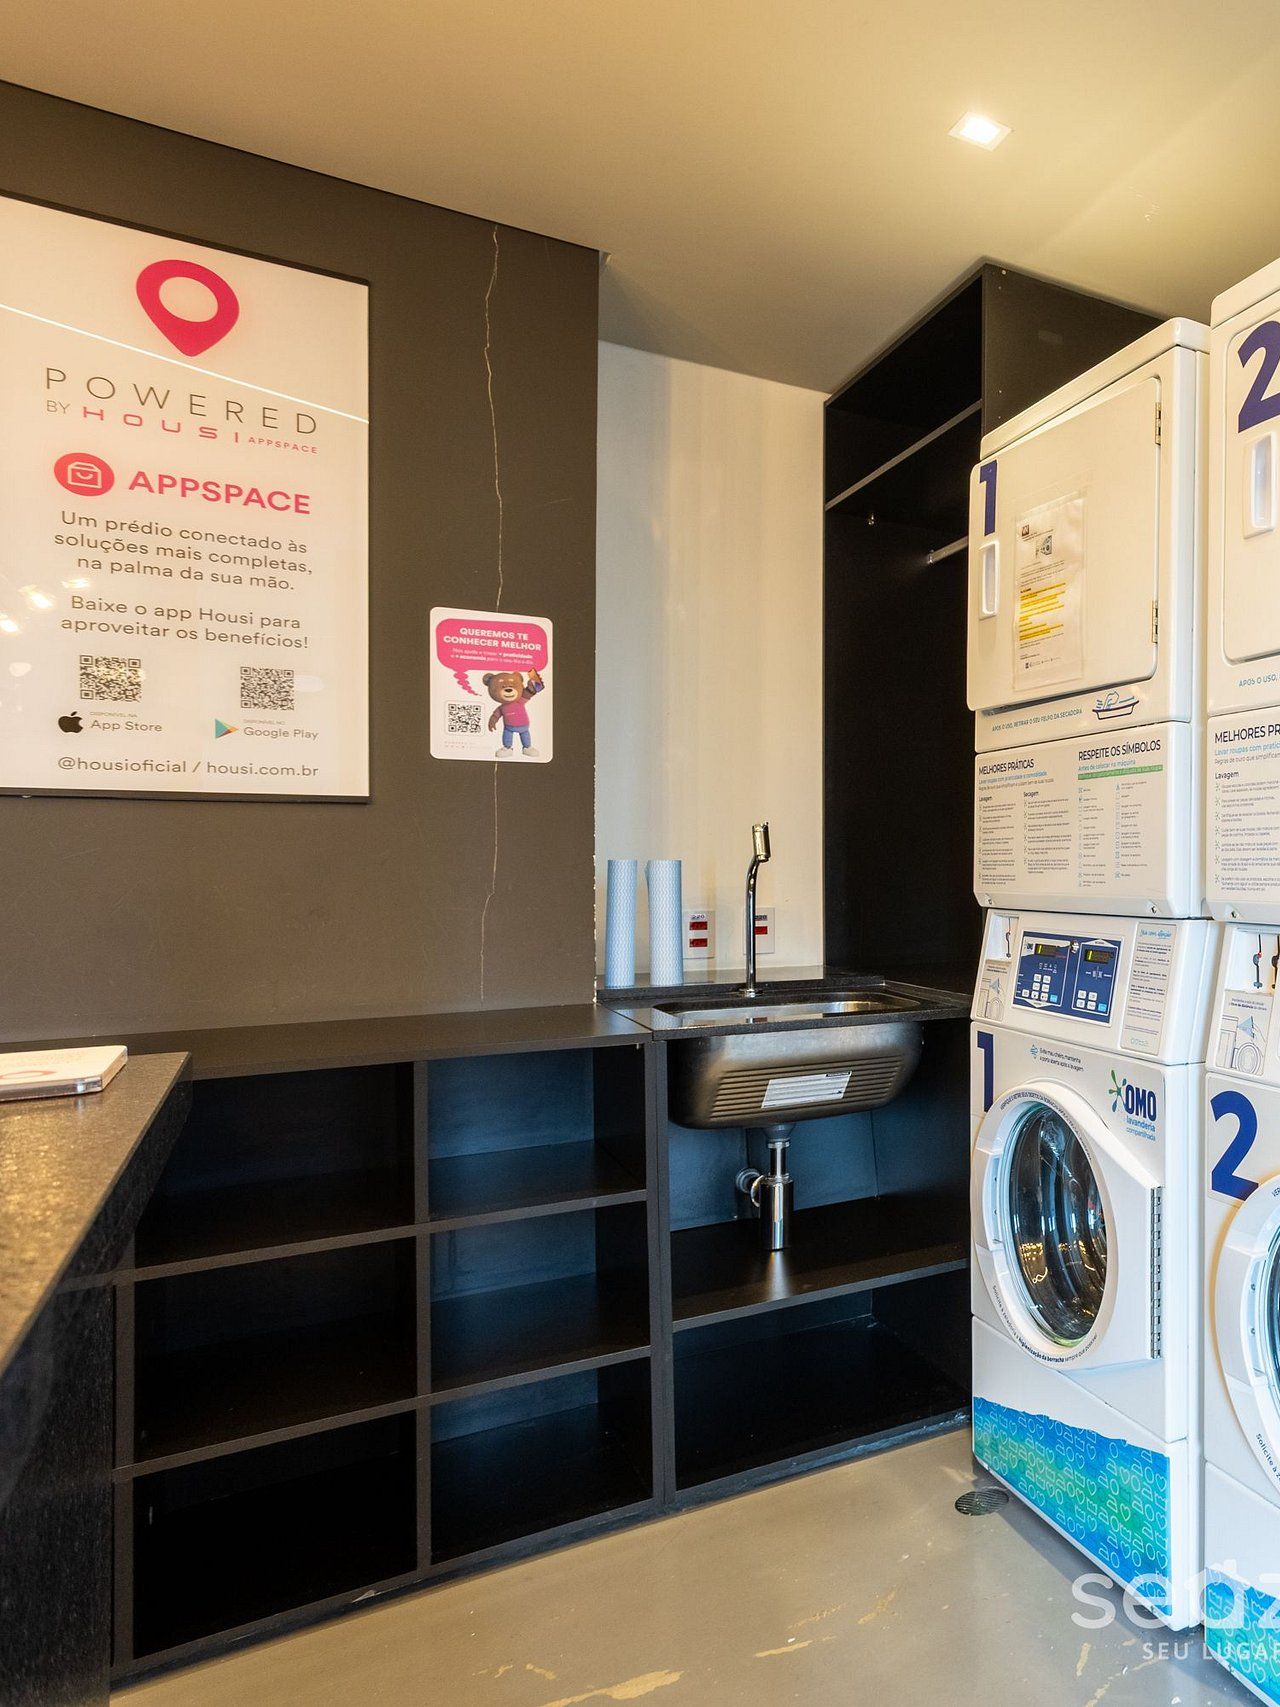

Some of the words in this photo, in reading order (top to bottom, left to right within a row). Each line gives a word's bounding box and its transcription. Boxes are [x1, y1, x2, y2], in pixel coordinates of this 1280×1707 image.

[46, 367, 317, 435] POWERED
[46, 400, 70, 414] BY
[248, 436, 318, 454] APPSPACE
[128, 470, 311, 515] APPSPACE
[980, 460, 997, 536] 1
[60, 510, 96, 529] Um
[105, 518, 172, 538] prédio
[179, 528, 281, 550] conectado
[288, 537, 308, 553] às
[54, 534, 148, 556] soluções
[156, 545, 201, 562] mais
[208, 552, 313, 575] completas,
[76, 557, 101, 570] na
[110, 560, 172, 578] palma
[179, 565, 203, 581] da
[210, 571, 242, 585] sua
[249, 573, 295, 591] mão.
[70, 595, 127, 614] Baixe
[134, 604, 146, 615] o
[154, 605, 191, 622] app
[199, 606, 252, 625] Housi
[260, 615, 301, 629] para
[60, 618, 169, 638] aproveitar
[176, 628, 197, 640] os
[205, 627, 309, 649] benefícios!
[443, 635, 499, 647] CONHECER
[501, 640, 542, 651] MELHOR
[460, 627, 514, 639] QUEREMOS
[516, 632, 528, 641] TE
[90, 719, 120, 733] App
[125, 720, 163, 732] Store
[242, 726, 288, 740] Google
[293, 728, 318, 741] Play
[1214, 725, 1265, 744] MELHORES
[978, 762, 1006, 775] MELHORES
[1008, 758, 1035, 771] PRÁTICAS
[1078, 747, 1108, 761] RESPEITE
[1110, 745, 1120, 757] OS
[1122, 740, 1162, 756] SÍMBOLOS
[56, 757, 185, 774] @housioficial
[207, 760, 319, 777] housi.com.br
[1214, 769, 1240, 779] Lavagem
[977, 1031, 994, 1112] 1
[1124, 1084, 1156, 1122] OMO
[1126, 1116, 1156, 1132] lavanderia
[1210, 1090, 1259, 1200] 2
